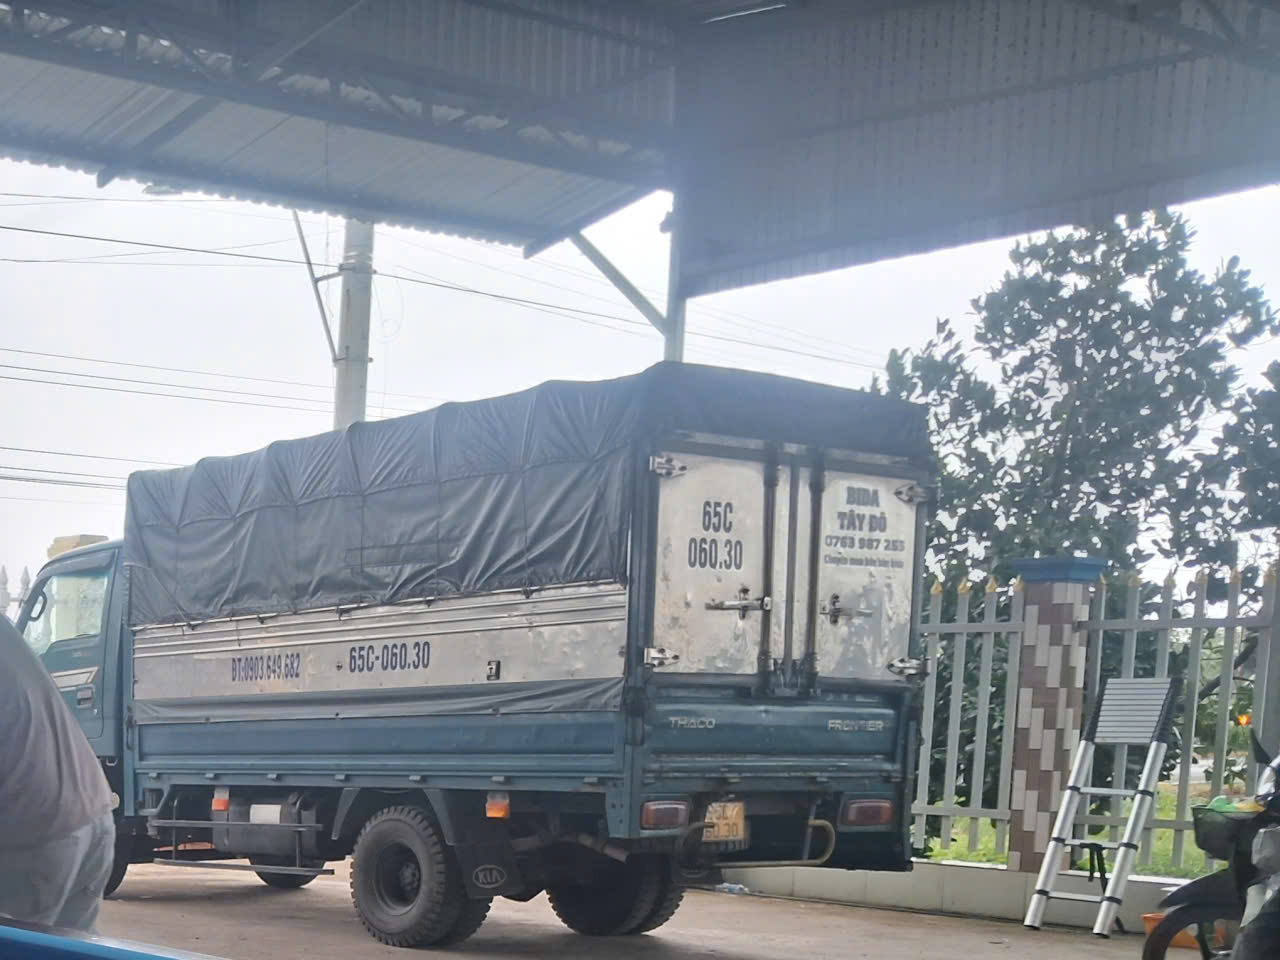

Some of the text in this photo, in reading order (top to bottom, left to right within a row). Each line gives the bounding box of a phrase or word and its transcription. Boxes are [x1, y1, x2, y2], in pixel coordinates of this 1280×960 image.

[702, 500, 733, 533] 65C
[837, 509, 865, 531] TÂY
[688, 537, 743, 570] 060.30
[349, 641, 431, 673] 65C-060.30
[669, 716, 716, 728] THACO
[478, 869, 501, 884] KIA
